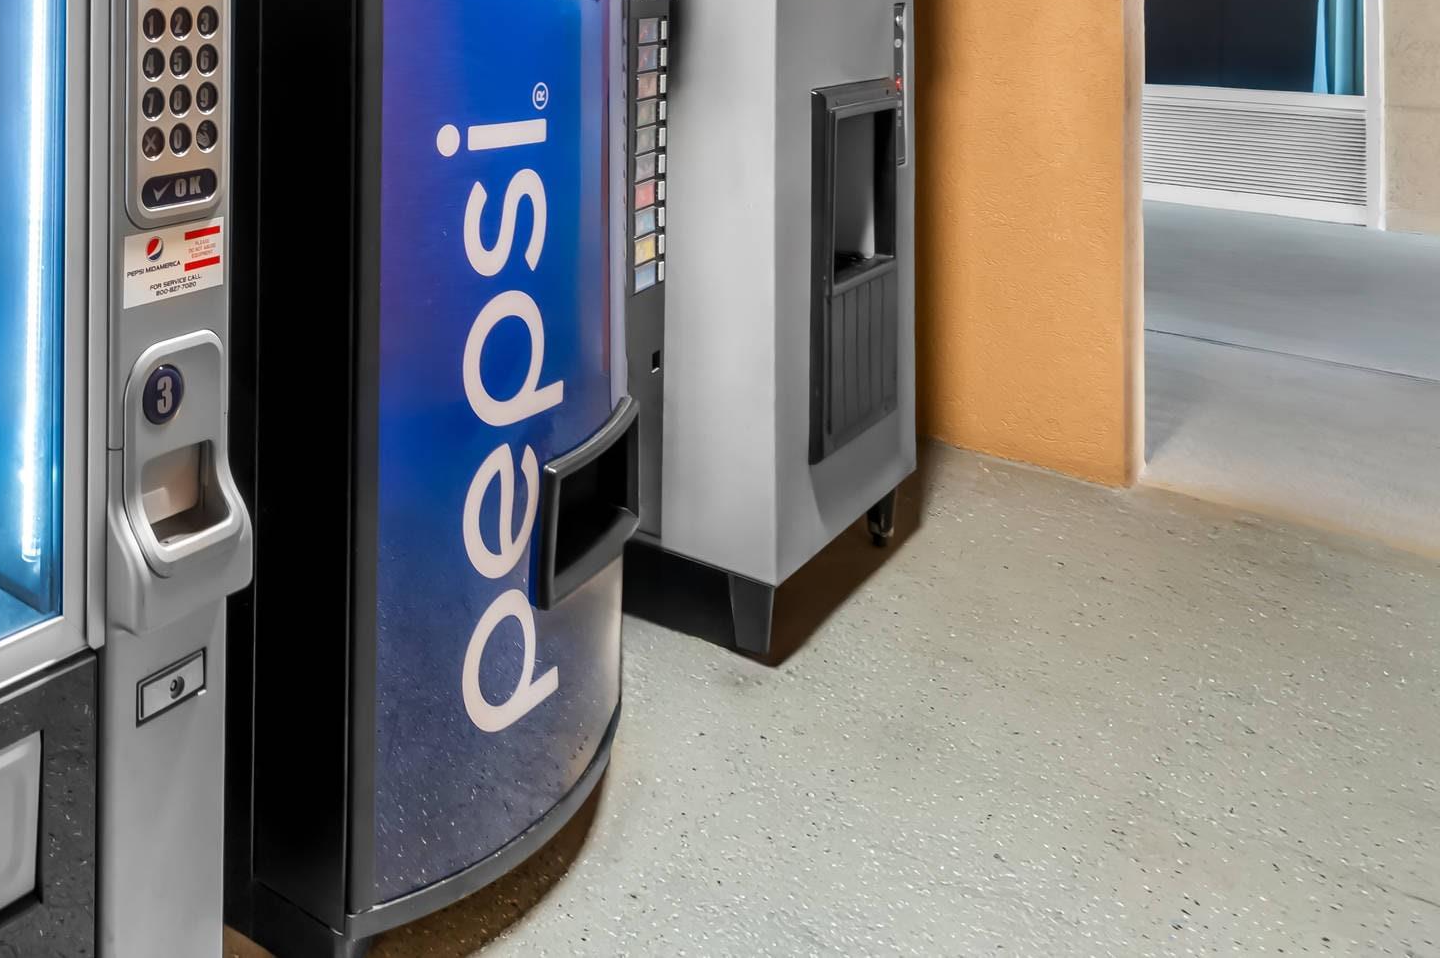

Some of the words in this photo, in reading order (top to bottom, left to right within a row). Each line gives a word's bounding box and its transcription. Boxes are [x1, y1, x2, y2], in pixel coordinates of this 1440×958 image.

[148, 16, 154, 35] 1
[174, 14, 183, 33] 2
[201, 13, 208, 32] 3
[146, 54, 154, 74] 4
[174, 53, 183, 72] 5
[200, 50, 208, 70] 6
[147, 94, 154, 114] 7
[200, 88, 208, 108] 9
[174, 130, 182, 149] 0
[175, 176, 202, 197] OK
[127, 269, 144, 278] PEPSI
[146, 260, 181, 273] MIDAMERICA
[163, 276, 187, 288] SERVICE
[157, 376, 173, 414] 3
[436, 118, 564, 733] pepsi
